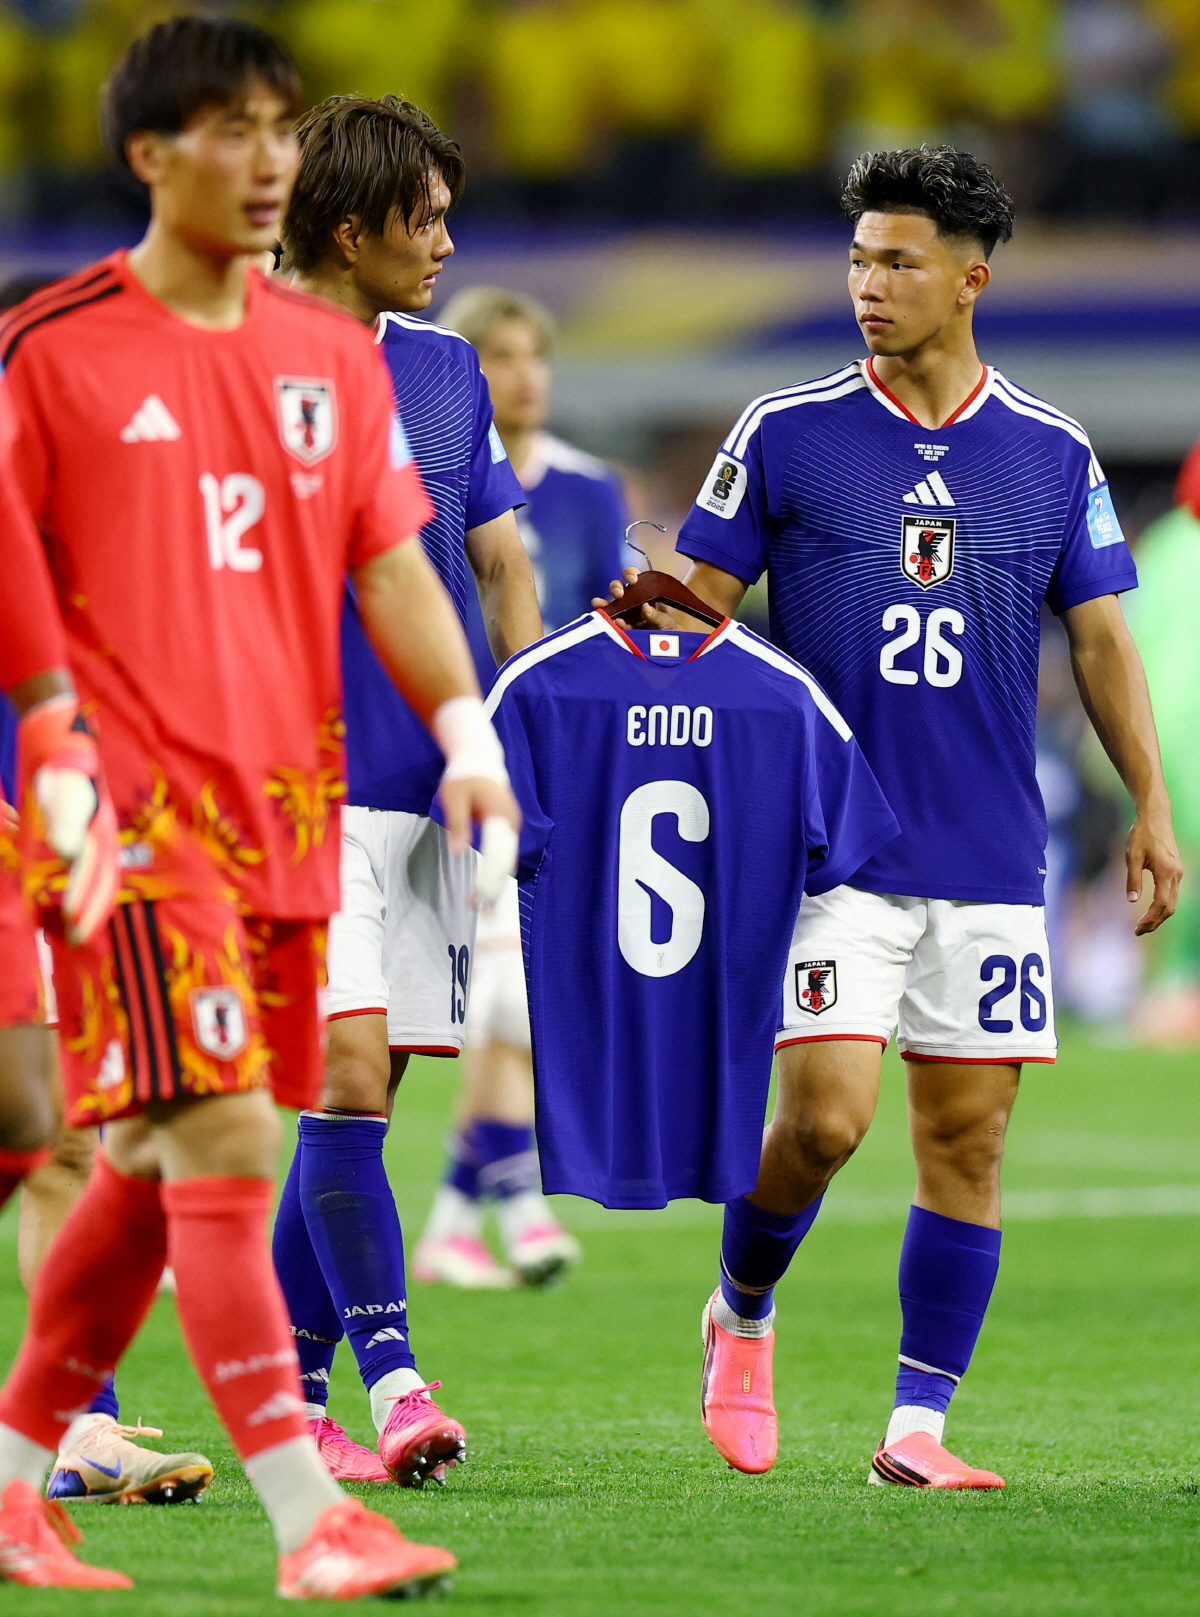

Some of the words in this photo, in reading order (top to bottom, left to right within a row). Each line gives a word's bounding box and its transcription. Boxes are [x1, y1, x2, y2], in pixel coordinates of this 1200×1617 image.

[198, 471, 266, 573] 12
[706, 499, 725, 512] 2026
[914, 519, 943, 528] JAPAN
[914, 564, 937, 577] JFA
[879, 604, 965, 688] 26
[627, 704, 714, 748] ENDO
[617, 779, 710, 978] 6
[447, 943, 469, 1025] 19
[978, 952, 1047, 1034] 26
[344, 1298, 407, 1319] JAPAN
